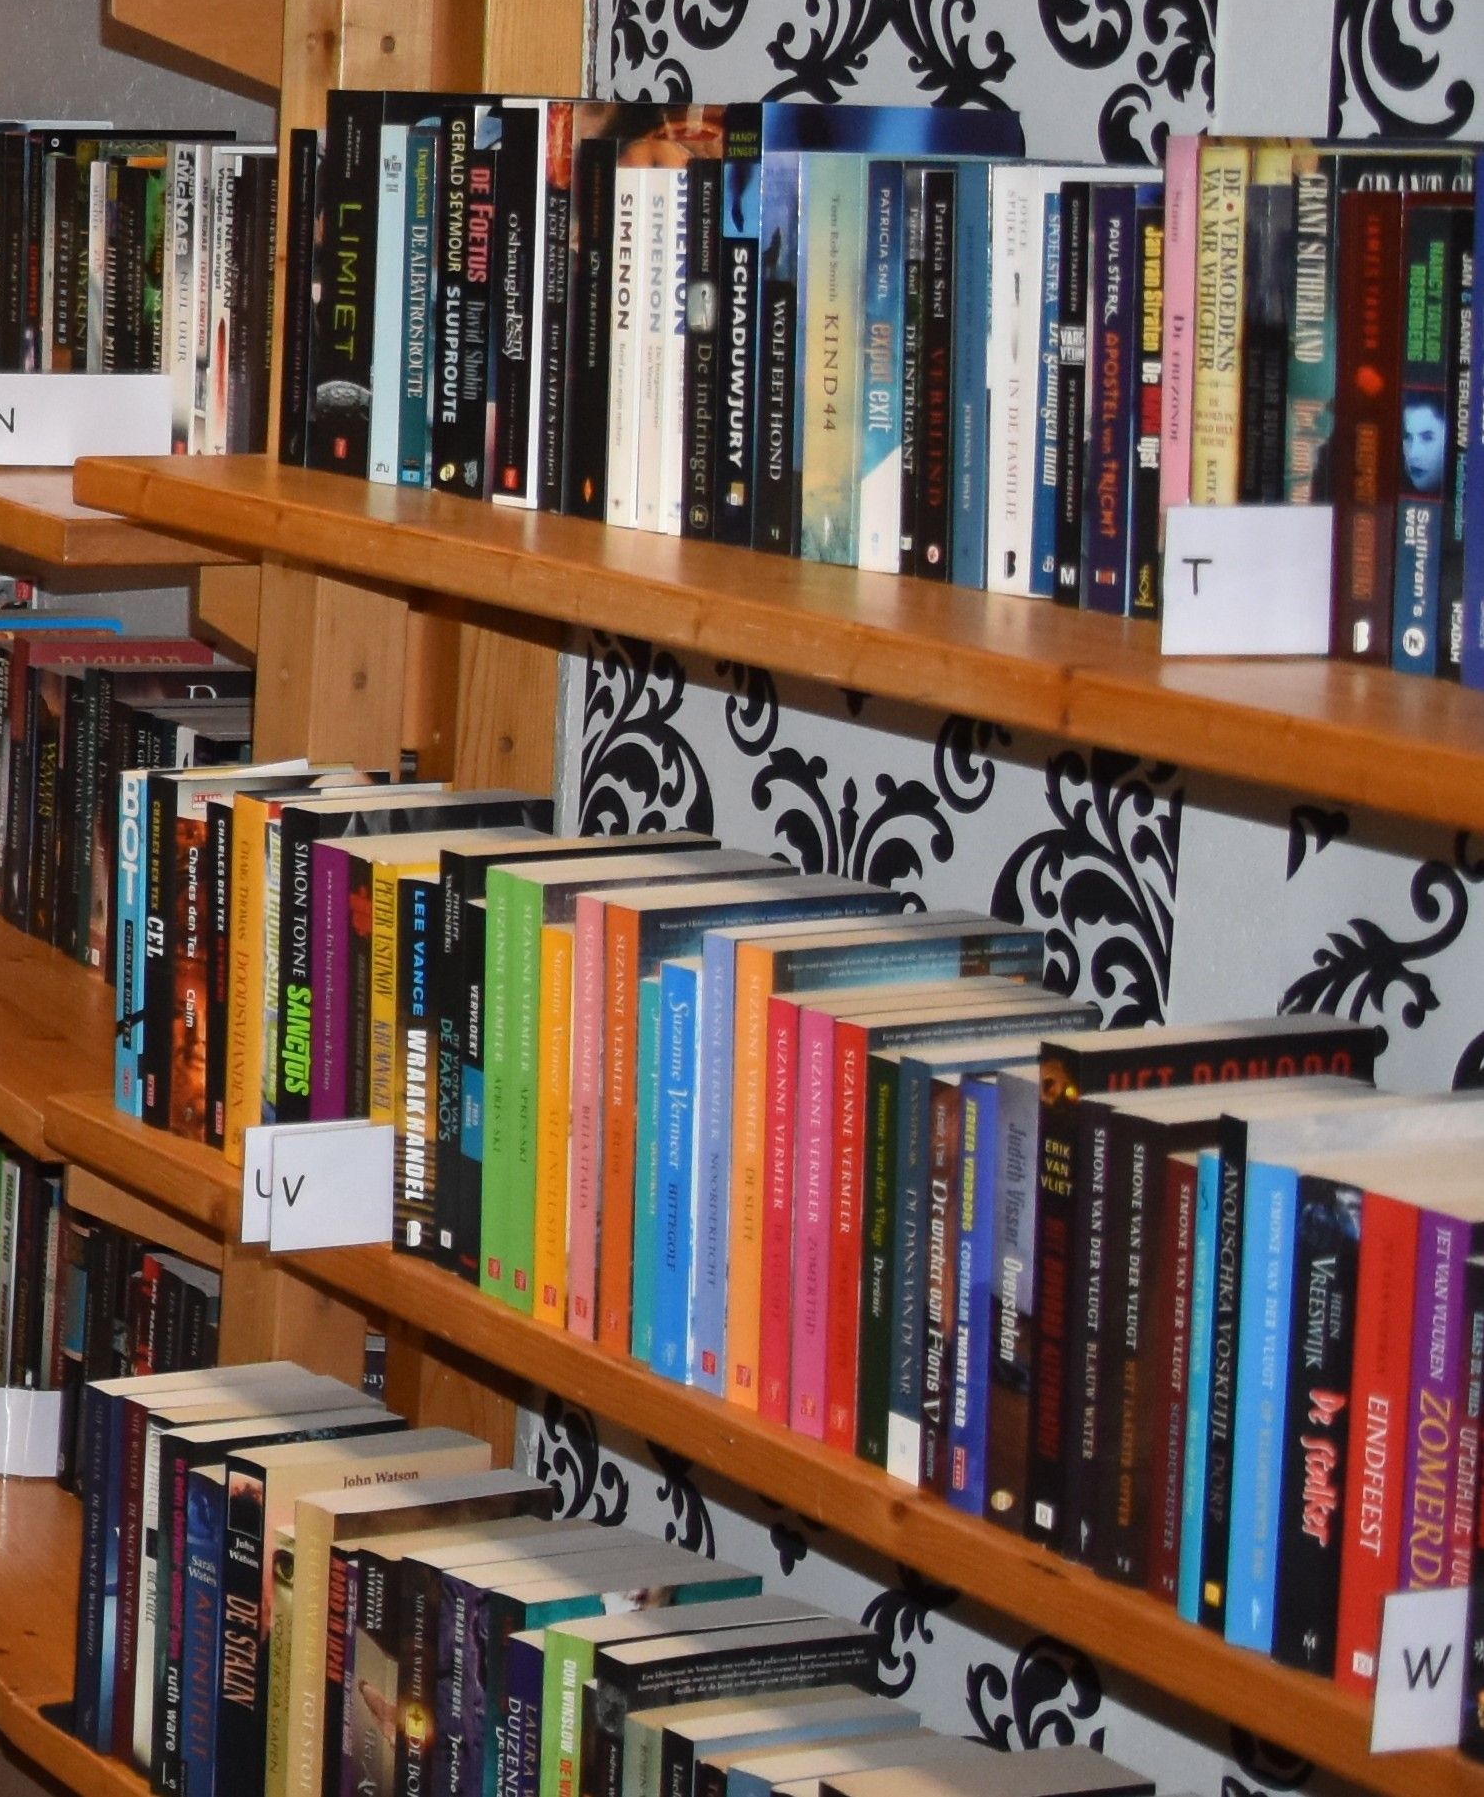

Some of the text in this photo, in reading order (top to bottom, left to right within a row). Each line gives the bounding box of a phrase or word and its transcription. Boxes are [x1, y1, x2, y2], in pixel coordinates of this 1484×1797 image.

[331, 202, 363, 361] LIMIET
[442, 120, 466, 425] GERALD SEYMOUR SLUIPROUTE
[617, 192, 634, 332] SIMENON
[1104, 219, 1121, 324] PAUL STERK
[1198, 168, 1222, 371] VAN MR WHICHER
[1218, 168, 1242, 373] DE VERMOEDENS
[1295, 173, 1328, 364] GRANT SUTHERLAND
[729, 246, 748, 469] SCHADUWJURY
[768, 300, 788, 482] WOLF EET HOND
[822, 313, 840, 433] KIND 44
[1181, 557, 1214, 597] T
[1404, 506, 1417, 547] wet
[1411, 506, 1431, 618] Sullivan's
[187, 907, 197, 933] den
[188, 846, 198, 903] Charles
[291, 841, 310, 978] SIMON TOYNE
[185, 988, 196, 1029] Claim
[411, 890, 426, 1017] LEE VANCE
[285, 983, 312, 1097] SANCTUS
[404, 1029, 427, 1202] WRAAKHANDEL
[666, 992, 690, 1273] Suzanne Vermeer HITTEGOLF
[1009, 1122, 1028, 1192] Judith
[282, 1175, 305, 1207] V
[954, 1241, 973, 1428] CODENAAM ZWARTE KRAB
[1000, 1256, 1023, 1363] Oversteken
[1211, 1160, 1239, 1440] ANOUSCHKA VOSKUIJL
[1305, 1255, 1339, 1370] VREESWIJK
[342, 1469, 419, 1489] John Watson
[1358, 1392, 1390, 1557] EINDFEEST
[168, 1666, 180, 1704] ruth
[560, 1659, 577, 1754] DON WINSLOW
[1402, 1644, 1452, 1691] W
[165, 1708, 180, 1753] ware
